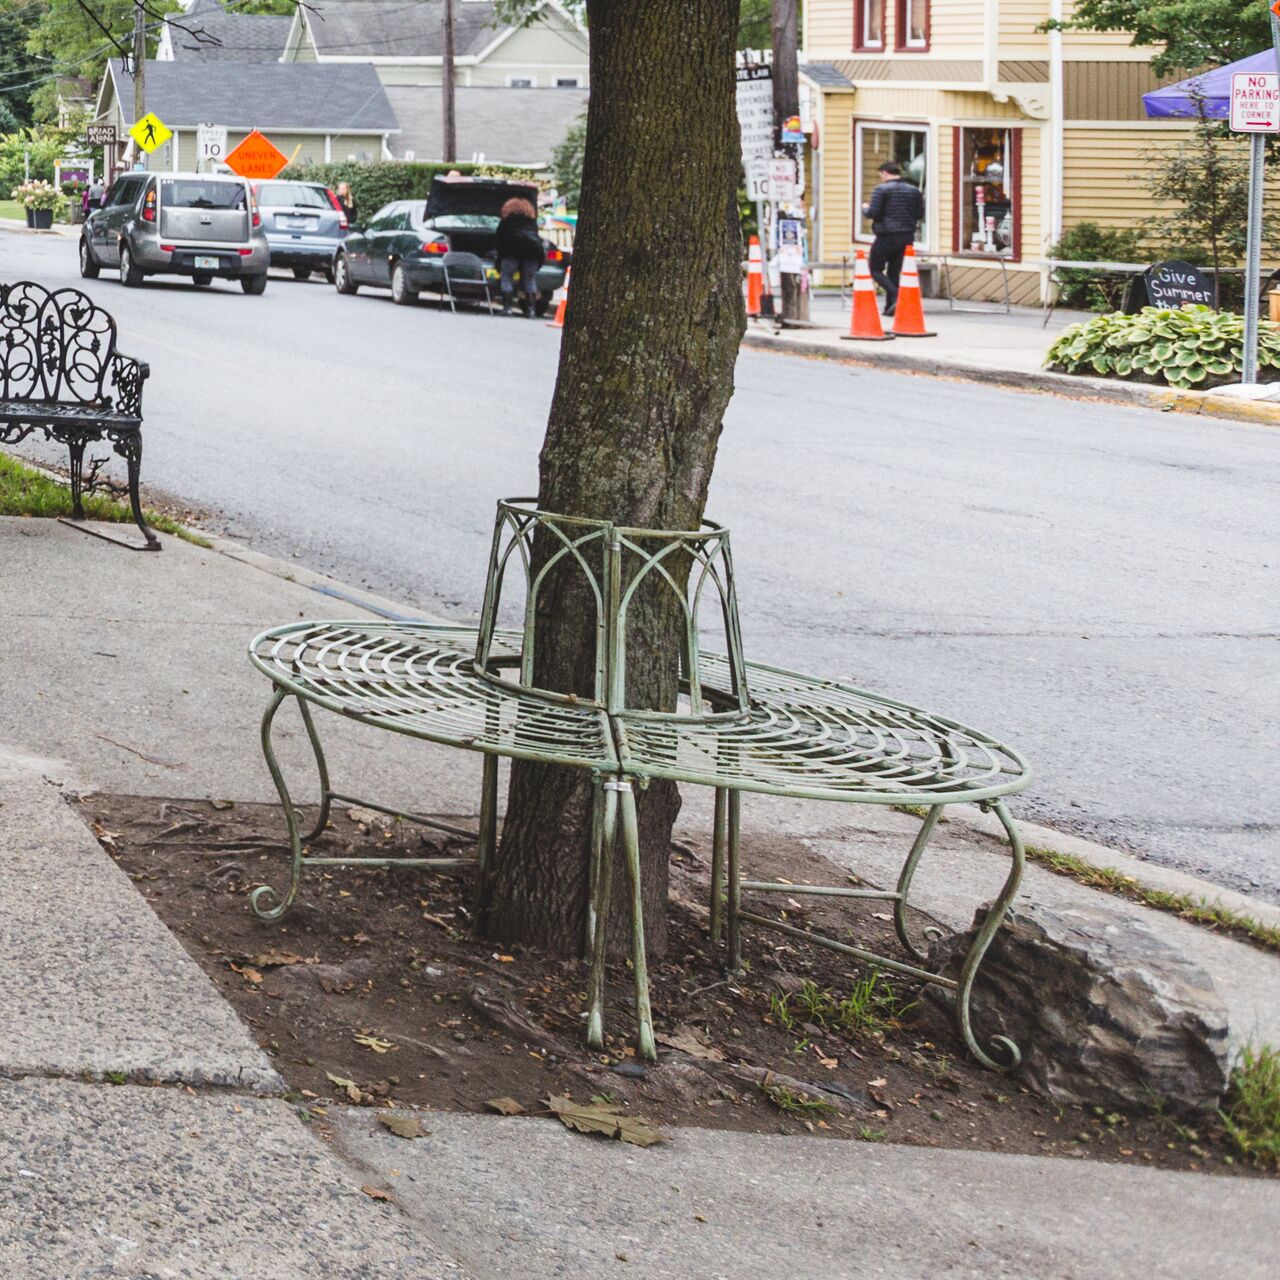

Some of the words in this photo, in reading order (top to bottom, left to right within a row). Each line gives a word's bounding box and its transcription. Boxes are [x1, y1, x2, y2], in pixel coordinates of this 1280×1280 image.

[1248, 77, 1266, 87] NO
[1235, 89, 1279, 100] PARKING
[205, 144, 220, 156] 10
[238, 152, 276, 160] UNEVEN
[241, 164, 274, 173] LANES
[1159, 268, 1196, 285] Give
[1151, 280, 1212, 302] Summer
[1155, 299, 1179, 310] the
